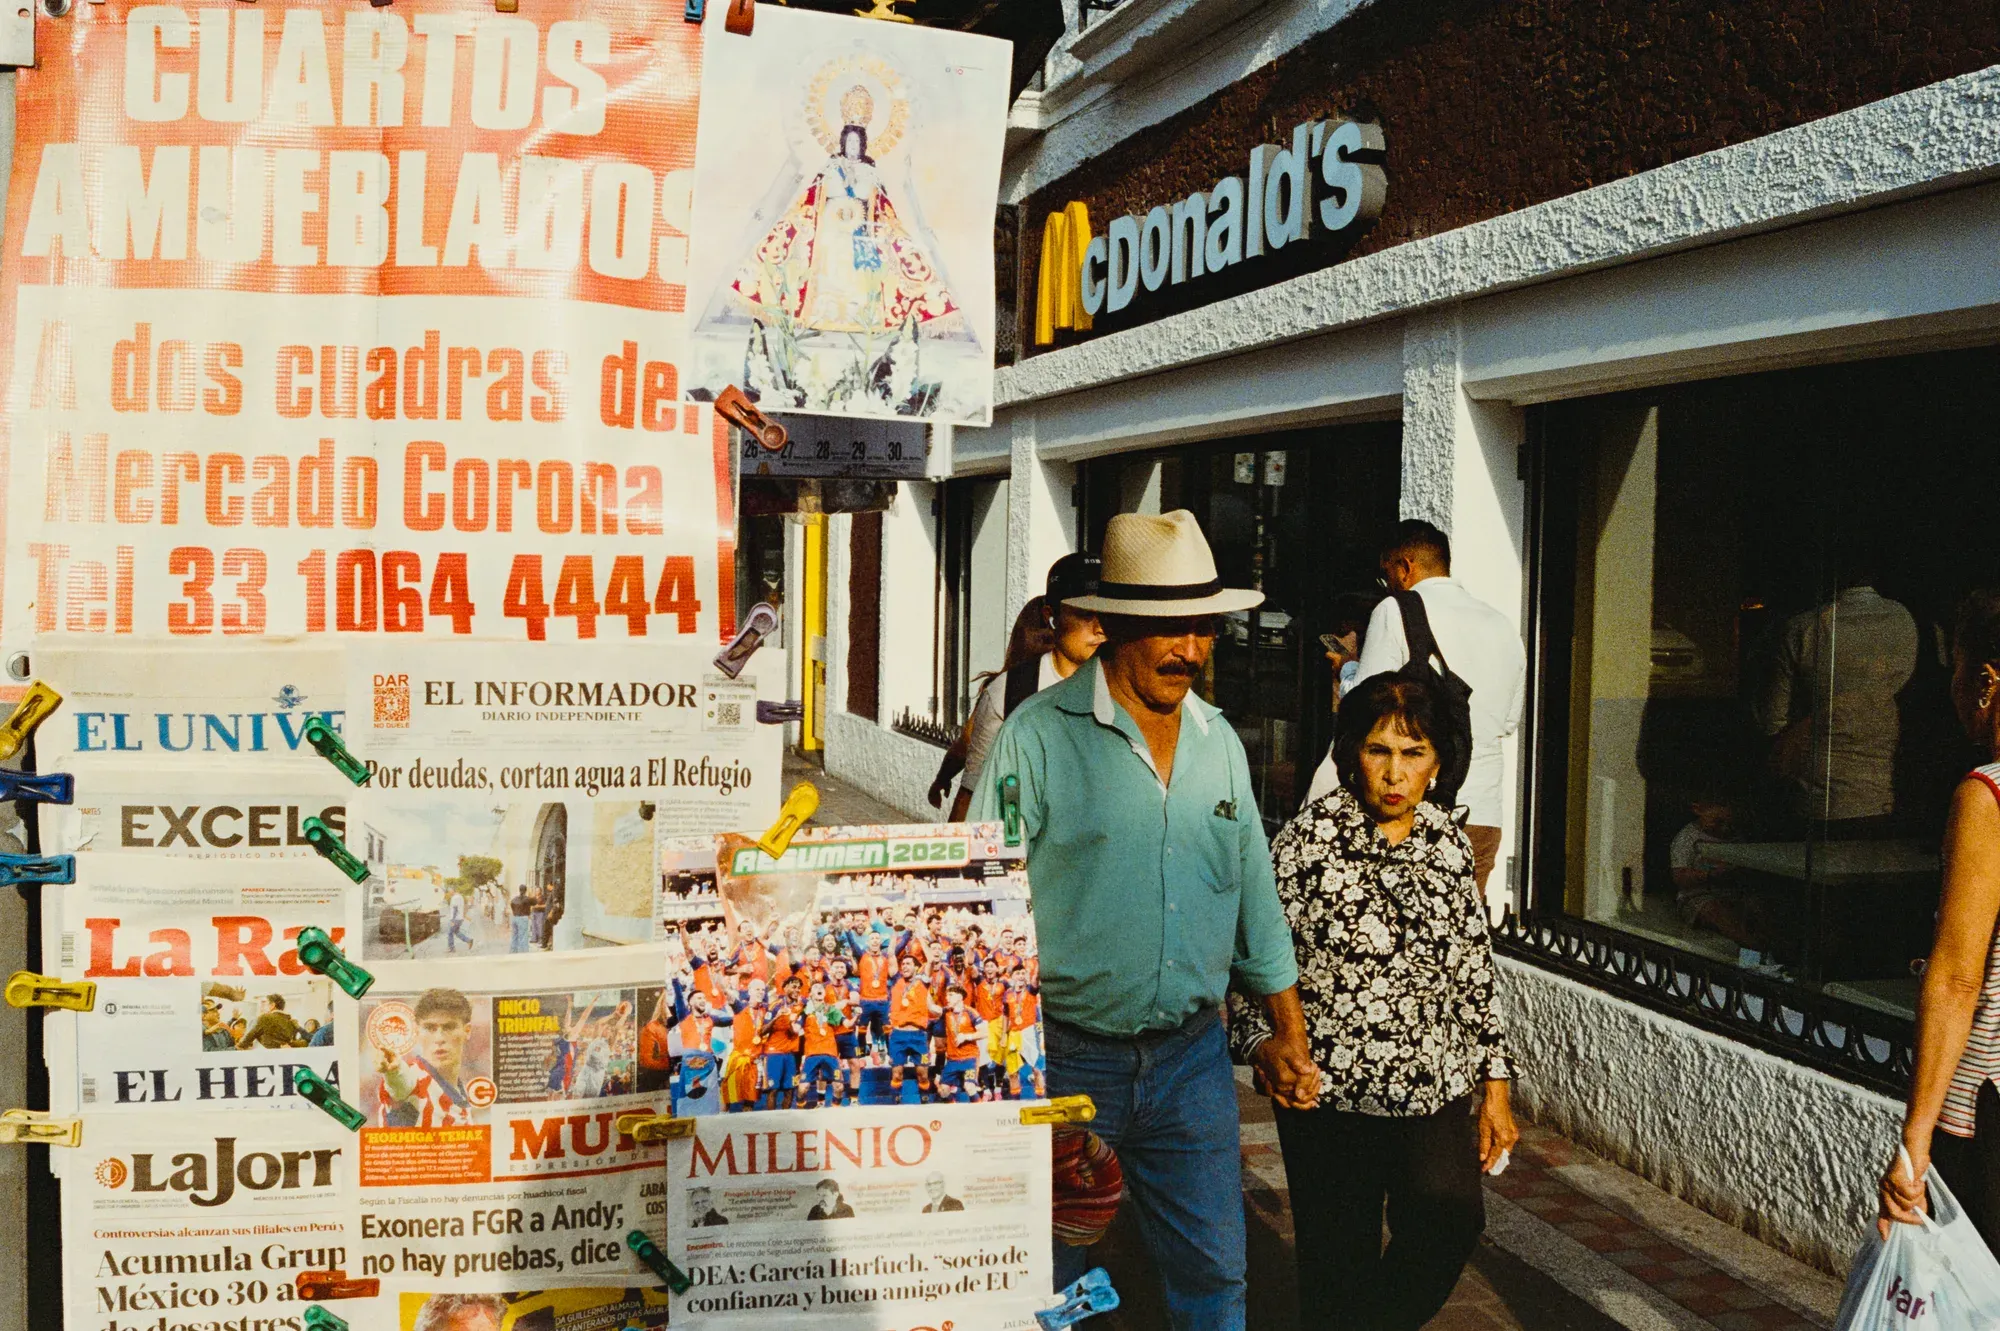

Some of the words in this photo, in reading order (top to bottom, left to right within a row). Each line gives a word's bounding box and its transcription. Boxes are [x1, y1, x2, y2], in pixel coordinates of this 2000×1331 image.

[124, 4, 611, 137] CUARTOS
[1035, 119, 1384, 346] McDonald's
[110, 322, 244, 416] dos
[275, 329, 569, 424] cuadras
[816, 441, 830, 461] 28
[852, 441, 866, 461] 29
[888, 442, 902, 462] 30
[43, 431, 378, 530] Mercado
[403, 440, 663, 536] Corona
[28, 542, 134, 634] Tel
[168, 546, 268, 635] 33
[297, 547, 476, 635] 1064
[503, 553, 702, 641] 4444
[373, 674, 409, 687] DAR
[424, 680, 464, 706] EL
[474, 679, 698, 708] INFORMADOR
[73, 712, 143, 752] EL
[482, 711, 532, 721] DIARIO
[536, 711, 643, 721] INDEPENDIENTE
[364, 758, 402, 789] Por
[409, 759, 494, 793] deudas,
[500, 761, 569, 789] cortan
[574, 765, 625, 798] agua
[629, 766, 641, 788] a
[646, 757, 667, 787] El
[673, 755, 752, 796] Refugio
[892, 841, 966, 863] 2026
[83, 918, 195, 979] La
[497, 1016, 560, 1034] TRIUNFAL
[499, 998, 540, 1016] INICIO
[112, 1069, 183, 1104] EL
[439, 1129, 483, 1142] TENAZ
[686, 1124, 933, 1179] MILENIO
[93, 1227, 176, 1240] Controversias
[177, 1225, 230, 1238] alcanzan
[231, 1226, 251, 1236] sus
[252, 1223, 292, 1236] filiales
[292, 1224, 308, 1233] en
[309, 1220, 337, 1232] Perú
[337, 1223, 345, 1232] y
[360, 1212, 465, 1239] Exonera
[472, 1208, 524, 1236] FGR
[529, 1211, 545, 1232] a
[552, 1200, 624, 1232] Andy;
[94, 1245, 254, 1278] Acumula
[362, 1253, 395, 1275] no
[402, 1247, 446, 1277] hay
[454, 1245, 564, 1278] pruebas,
[570, 1238, 621, 1265] dice
[687, 1262, 745, 1287] DEA:
[749, 1257, 824, 1283] García
[1001, 1246, 1029, 1265] de
[96, 1281, 220, 1314] México
[226, 1279, 269, 1307] 30
[686, 1289, 800, 1314] confianza
[801, 1289, 814, 1312] y
[821, 1282, 877, 1305] buen
[882, 1279, 951, 1302] amigo
[955, 1275, 981, 1293] de
